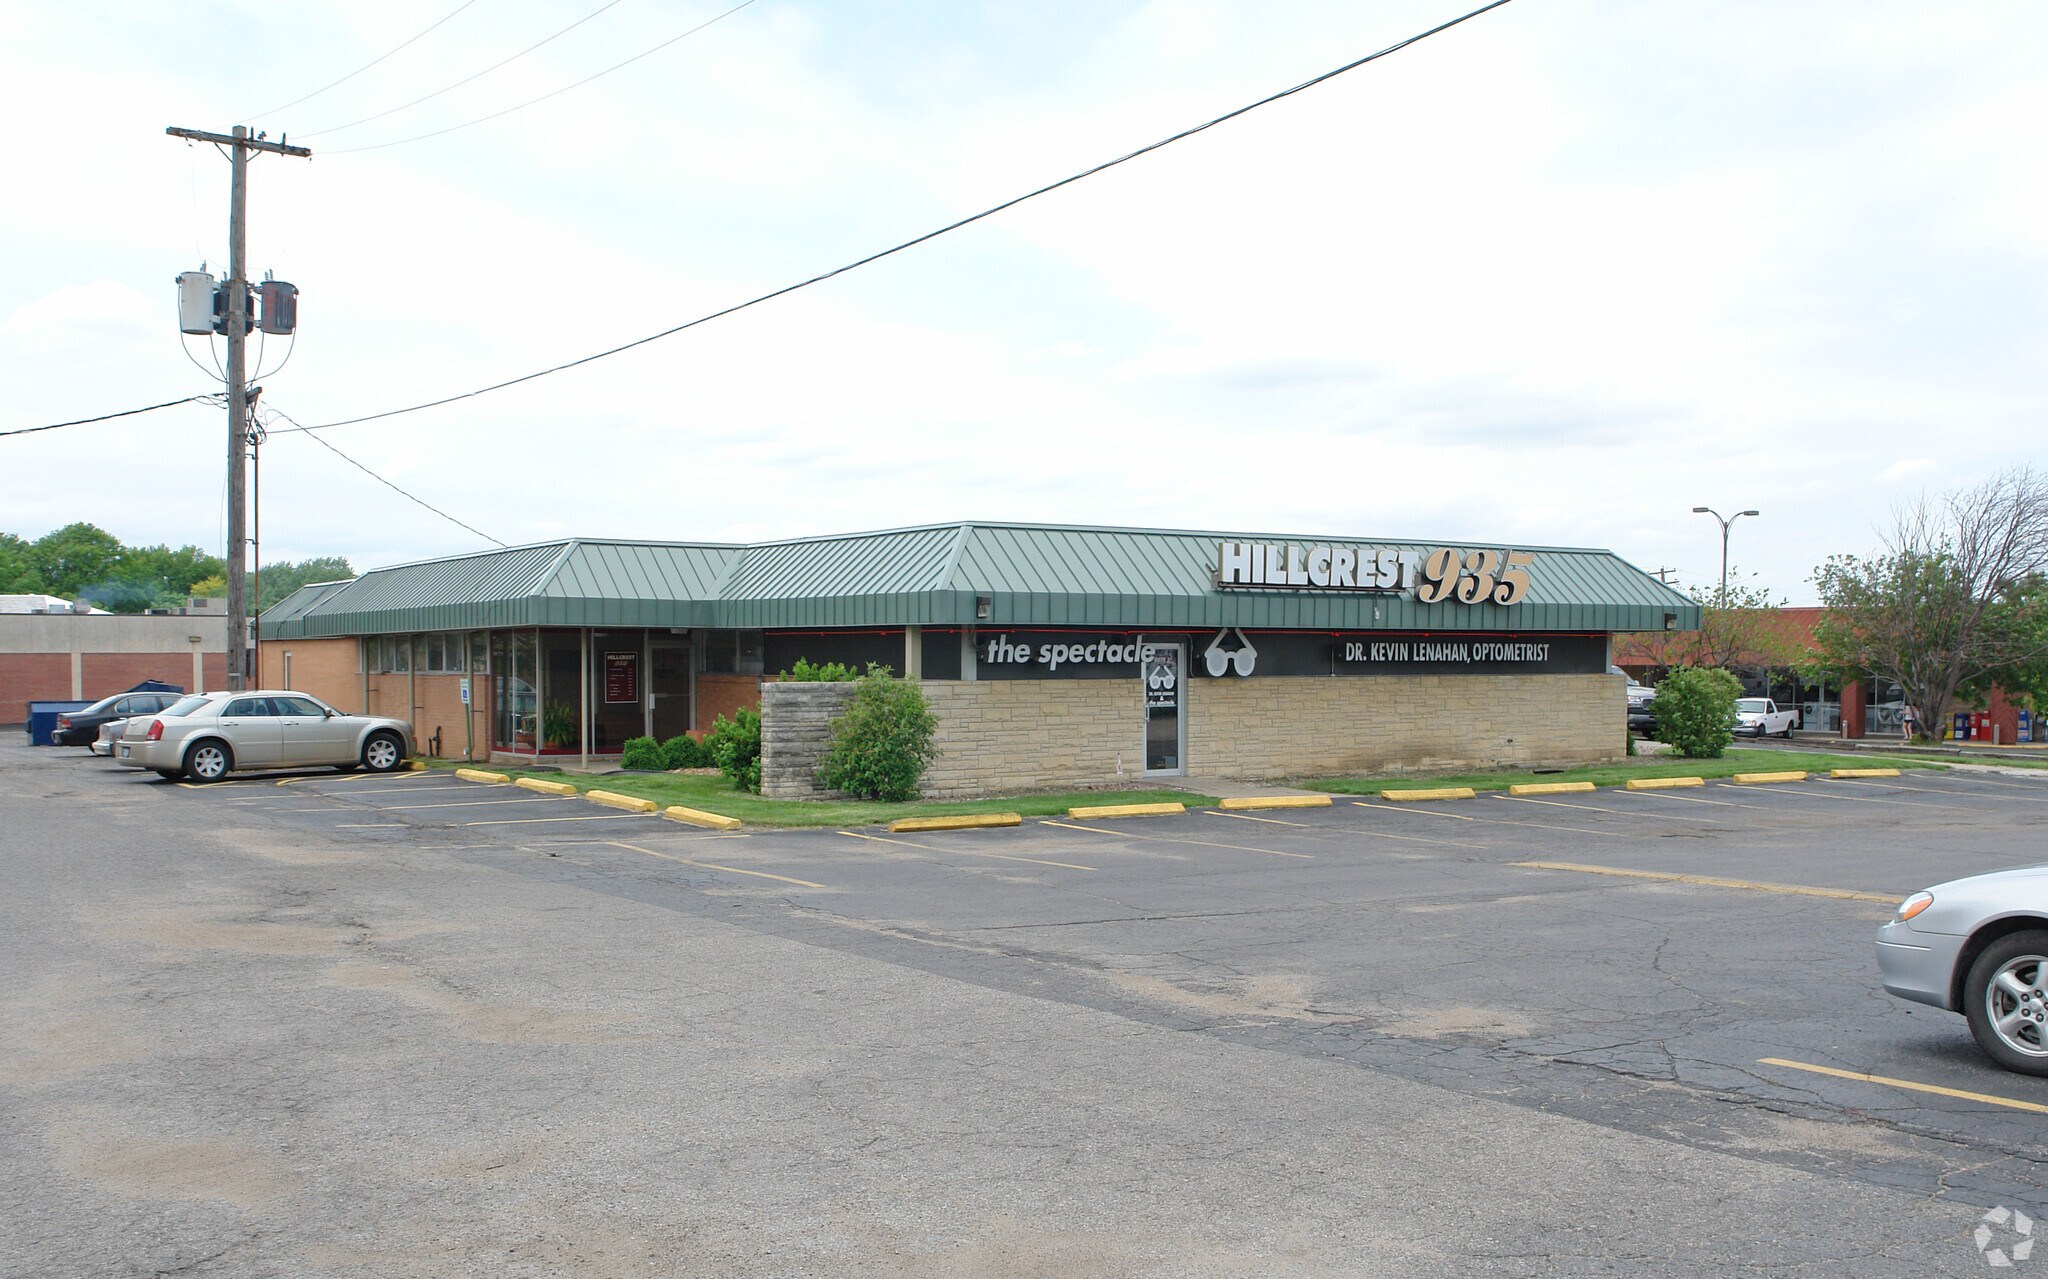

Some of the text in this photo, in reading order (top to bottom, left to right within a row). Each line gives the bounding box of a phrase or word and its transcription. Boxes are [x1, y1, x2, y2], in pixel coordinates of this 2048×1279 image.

[1221, 542, 1536, 606] HILLCREST 935
[987, 634, 1156, 671] the spectacle
[1345, 643, 1550, 663] DR. KEVIN LENAHAN, OPTOMETRIST
